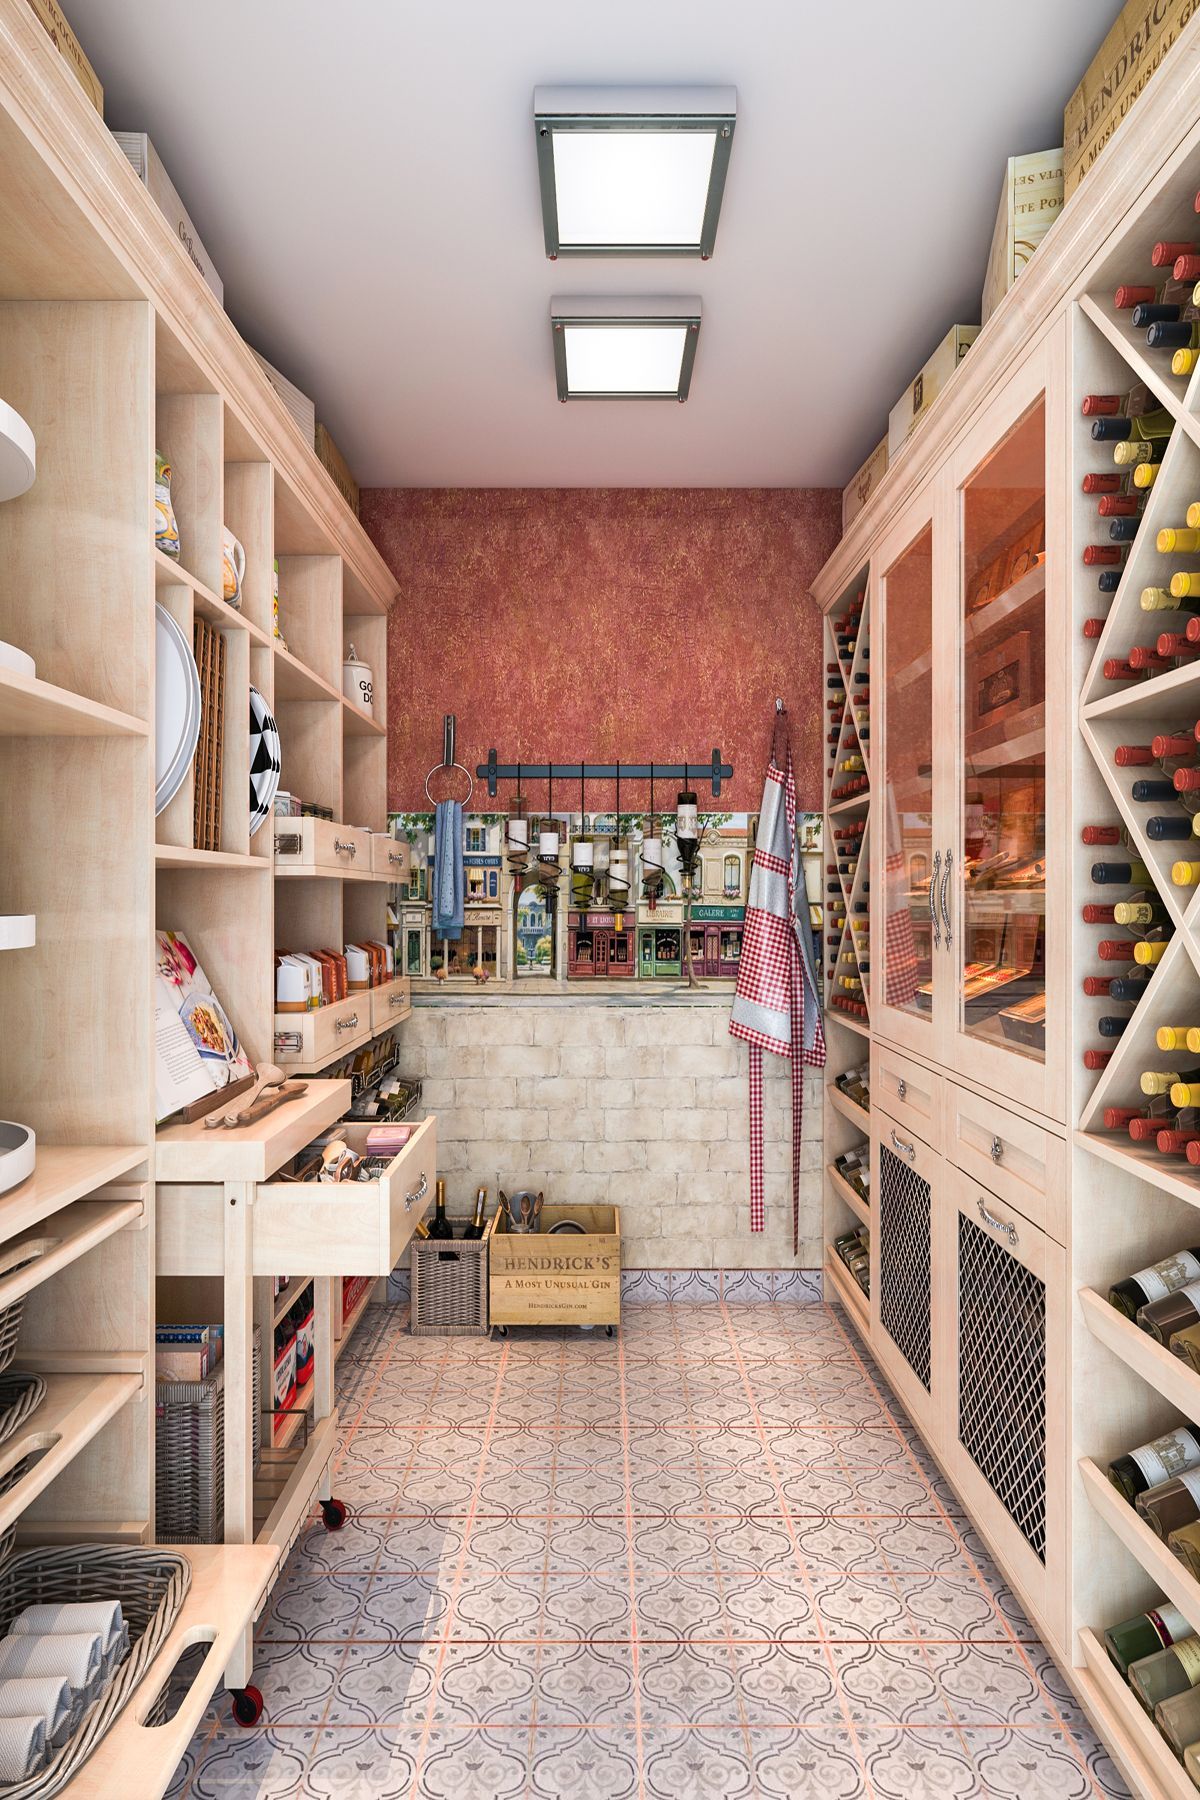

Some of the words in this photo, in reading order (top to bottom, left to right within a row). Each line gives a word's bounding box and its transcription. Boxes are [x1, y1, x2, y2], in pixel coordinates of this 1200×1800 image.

[1077, 0, 1174, 149] HENDRIC
[1078, 168, 1086, 184] A
[1088, 116, 1116, 167] MOST
[1120, 31, 1176, 117] UNUSUAL
[359, 680, 373, 692] GO
[505, 1256, 611, 1270] HENDRICK'S
[505, 1280, 512, 1288] A
[515, 1280, 542, 1288] MOST
[545, 1280, 589, 1288] UNUSUAL
[591, 1280, 611, 1288] GIN
